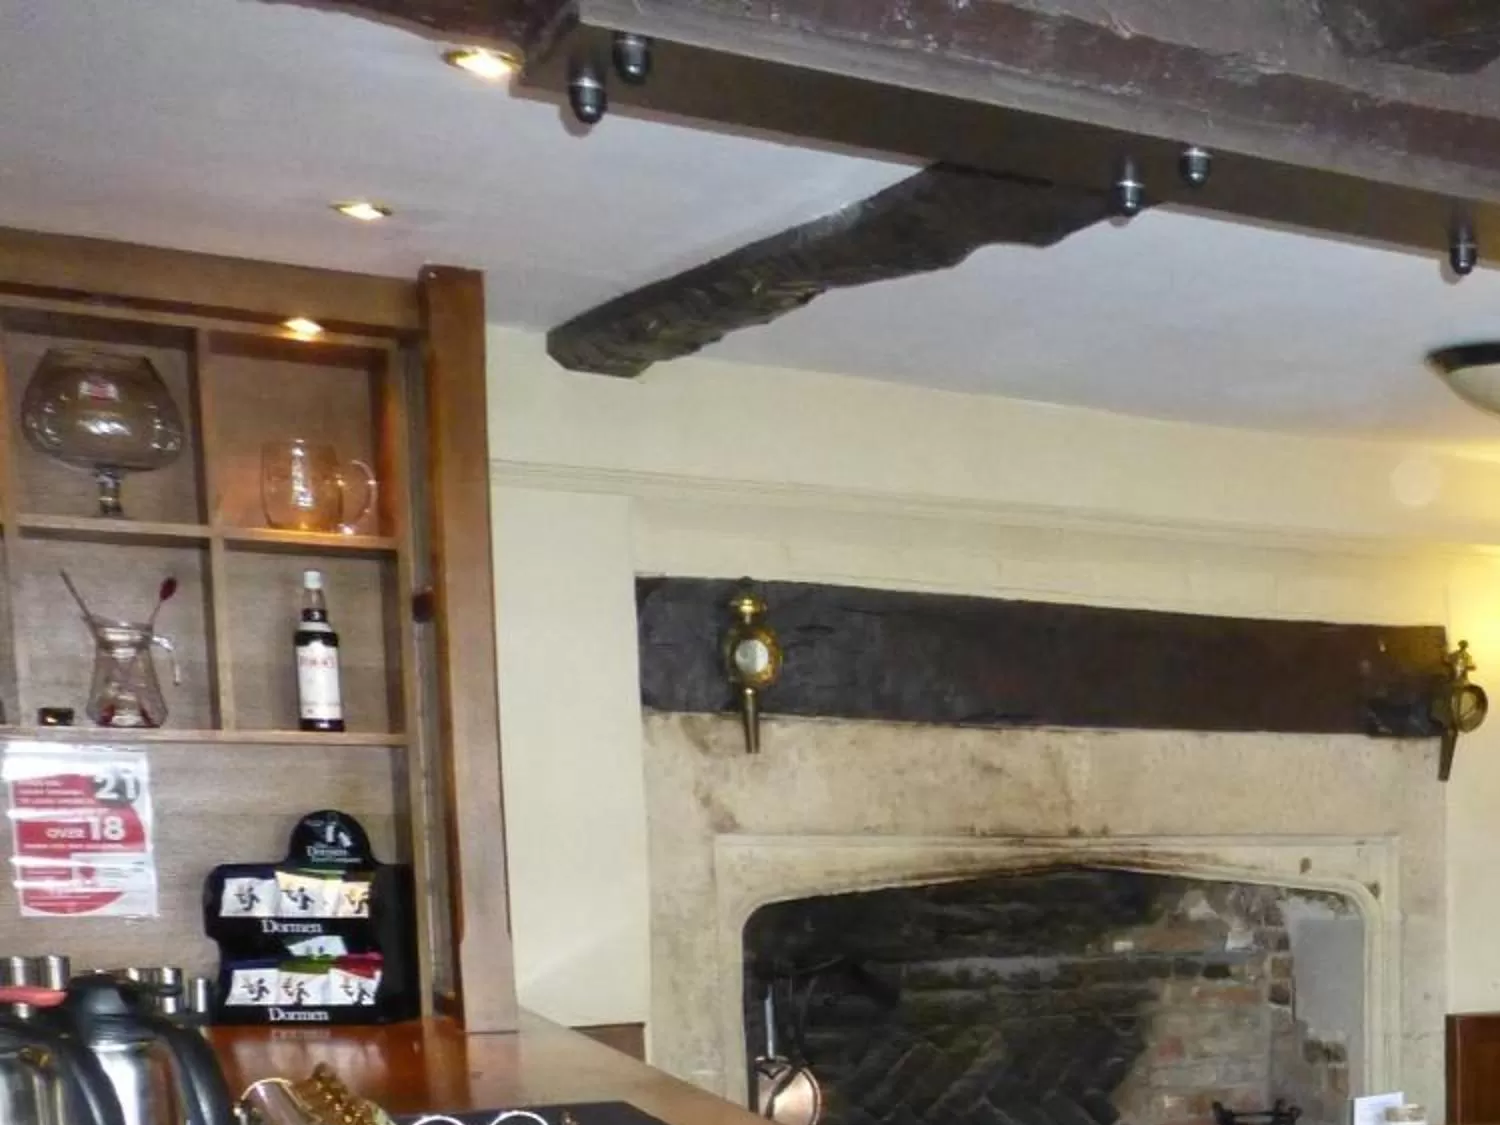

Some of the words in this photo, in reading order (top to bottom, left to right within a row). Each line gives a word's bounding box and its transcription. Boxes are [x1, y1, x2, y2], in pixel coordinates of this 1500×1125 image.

[88, 815, 126, 841] 18
[261, 919, 322, 934] Dormen
[268, 1007, 329, 1021] Dormen
